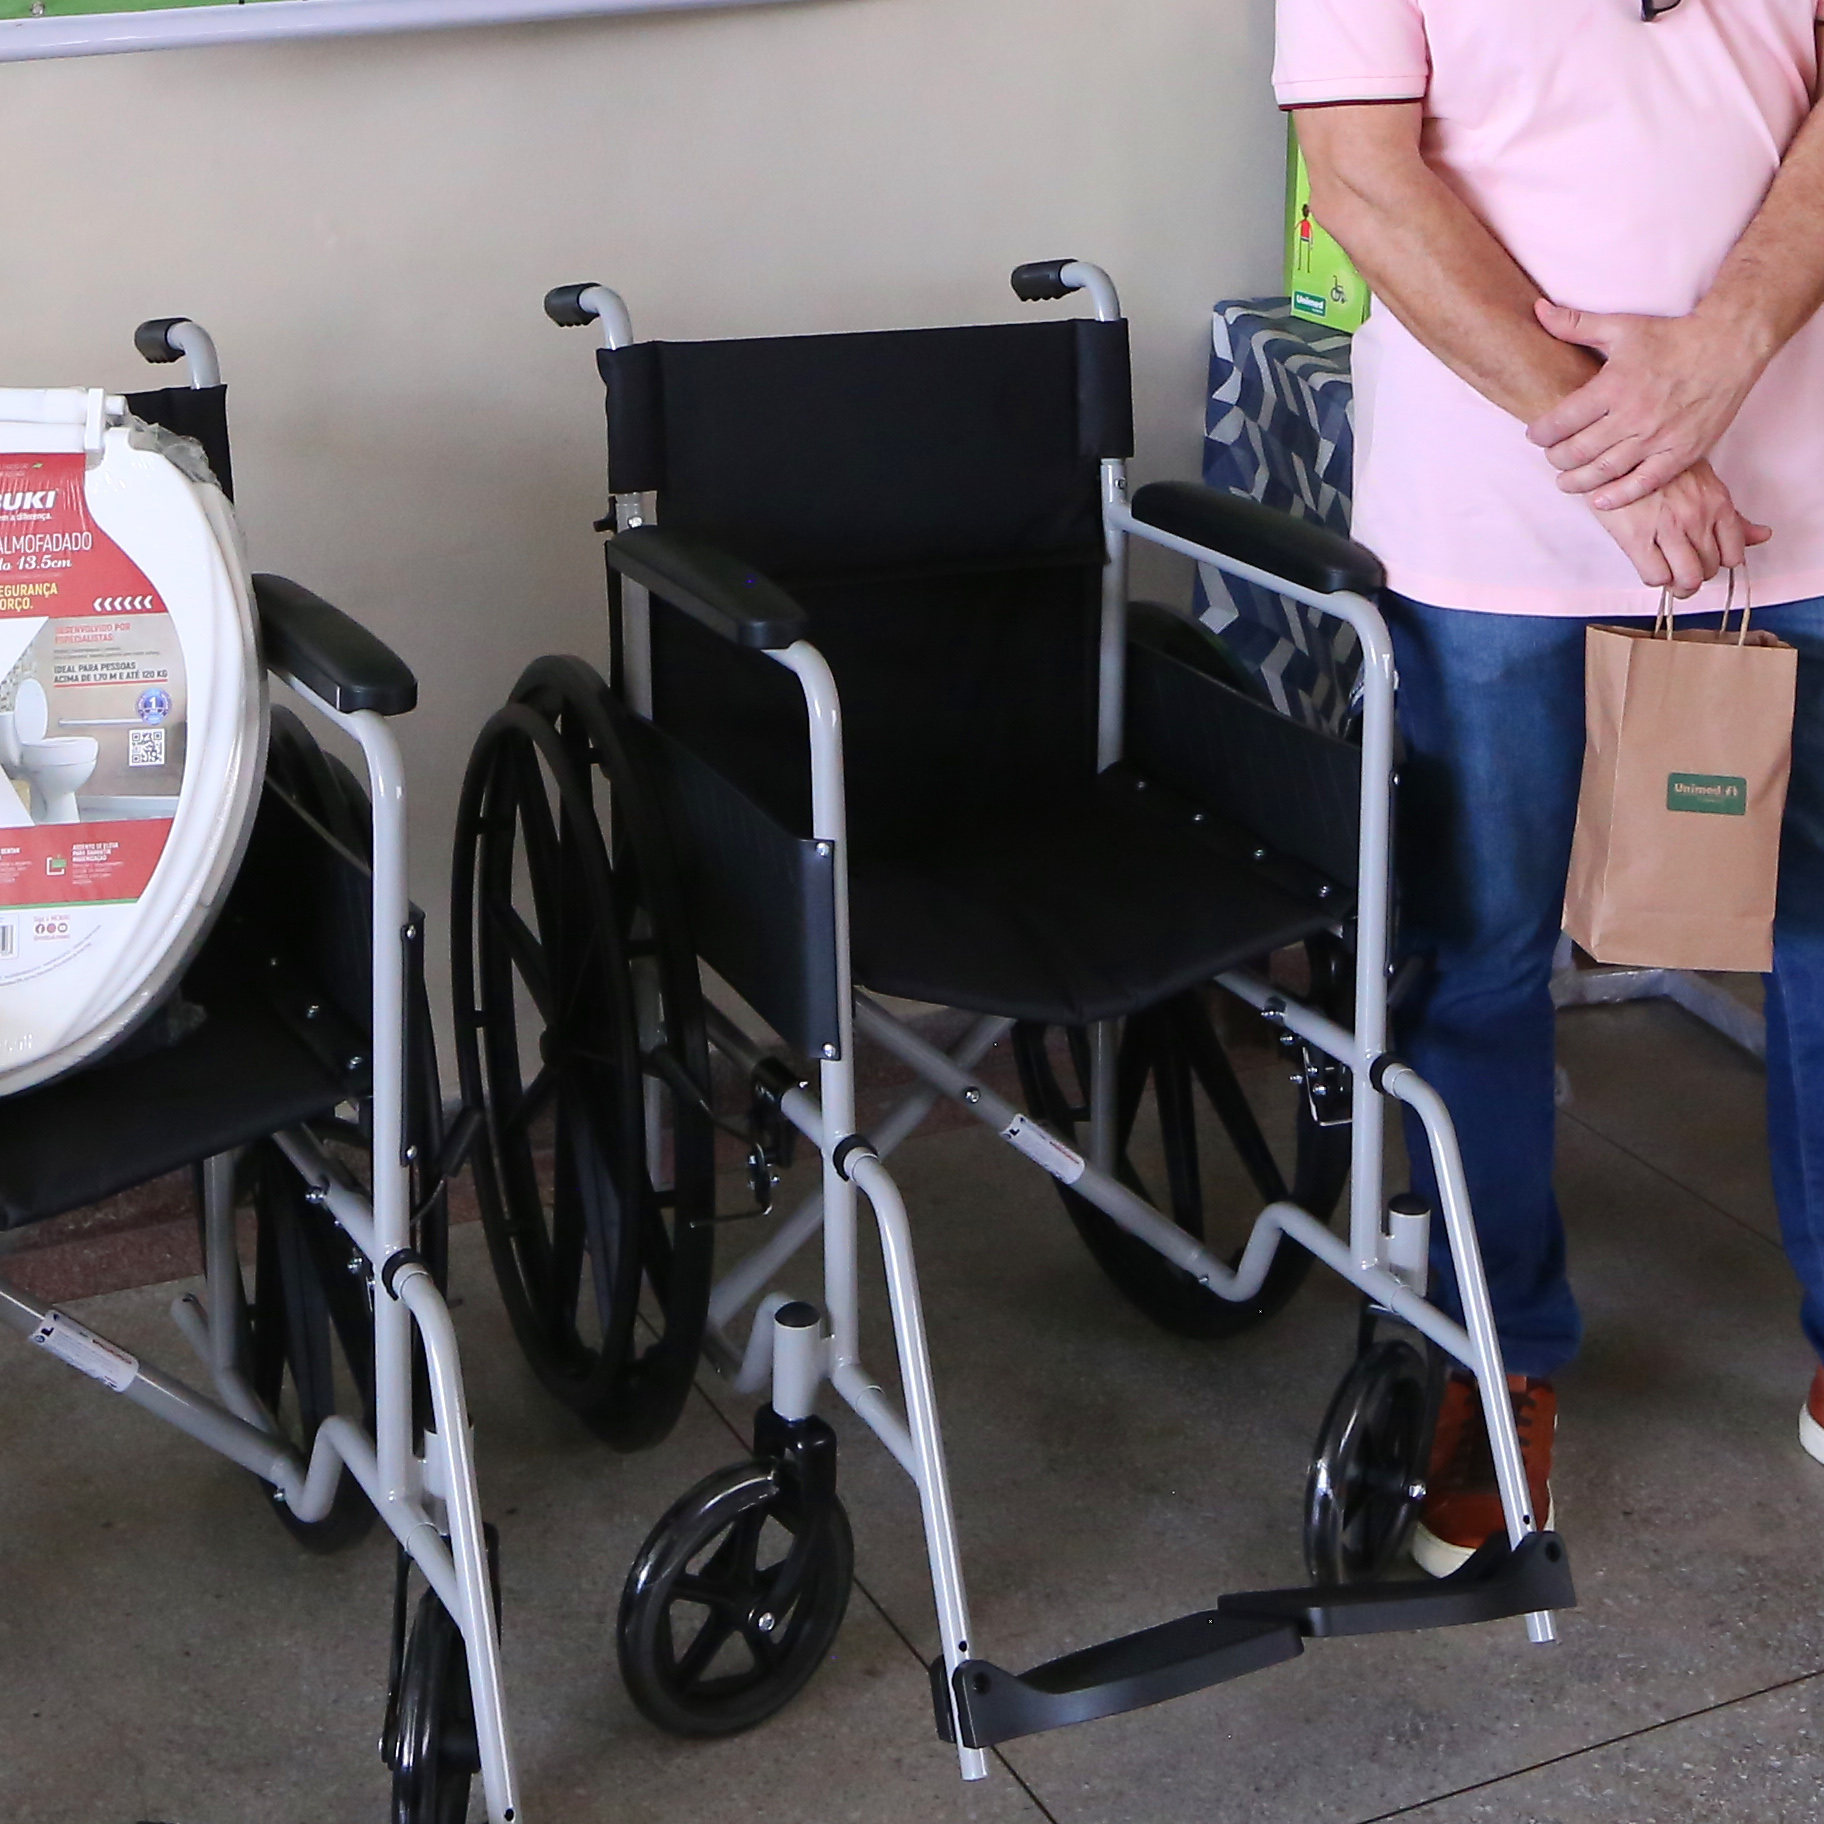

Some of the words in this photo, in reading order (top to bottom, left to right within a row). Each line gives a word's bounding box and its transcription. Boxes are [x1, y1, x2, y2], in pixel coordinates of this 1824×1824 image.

[16, 555, 72, 570] 13.5cm
[54, 665, 76, 674] IDEAL
[78, 663, 98, 672] PARA
[101, 662, 136, 671] PESSOAS
[54, 674, 78, 683] ACIMA
[125, 669, 139, 679] ATÉ
[142, 670, 155, 678] 120
[1674, 783, 1721, 796] Unimed
